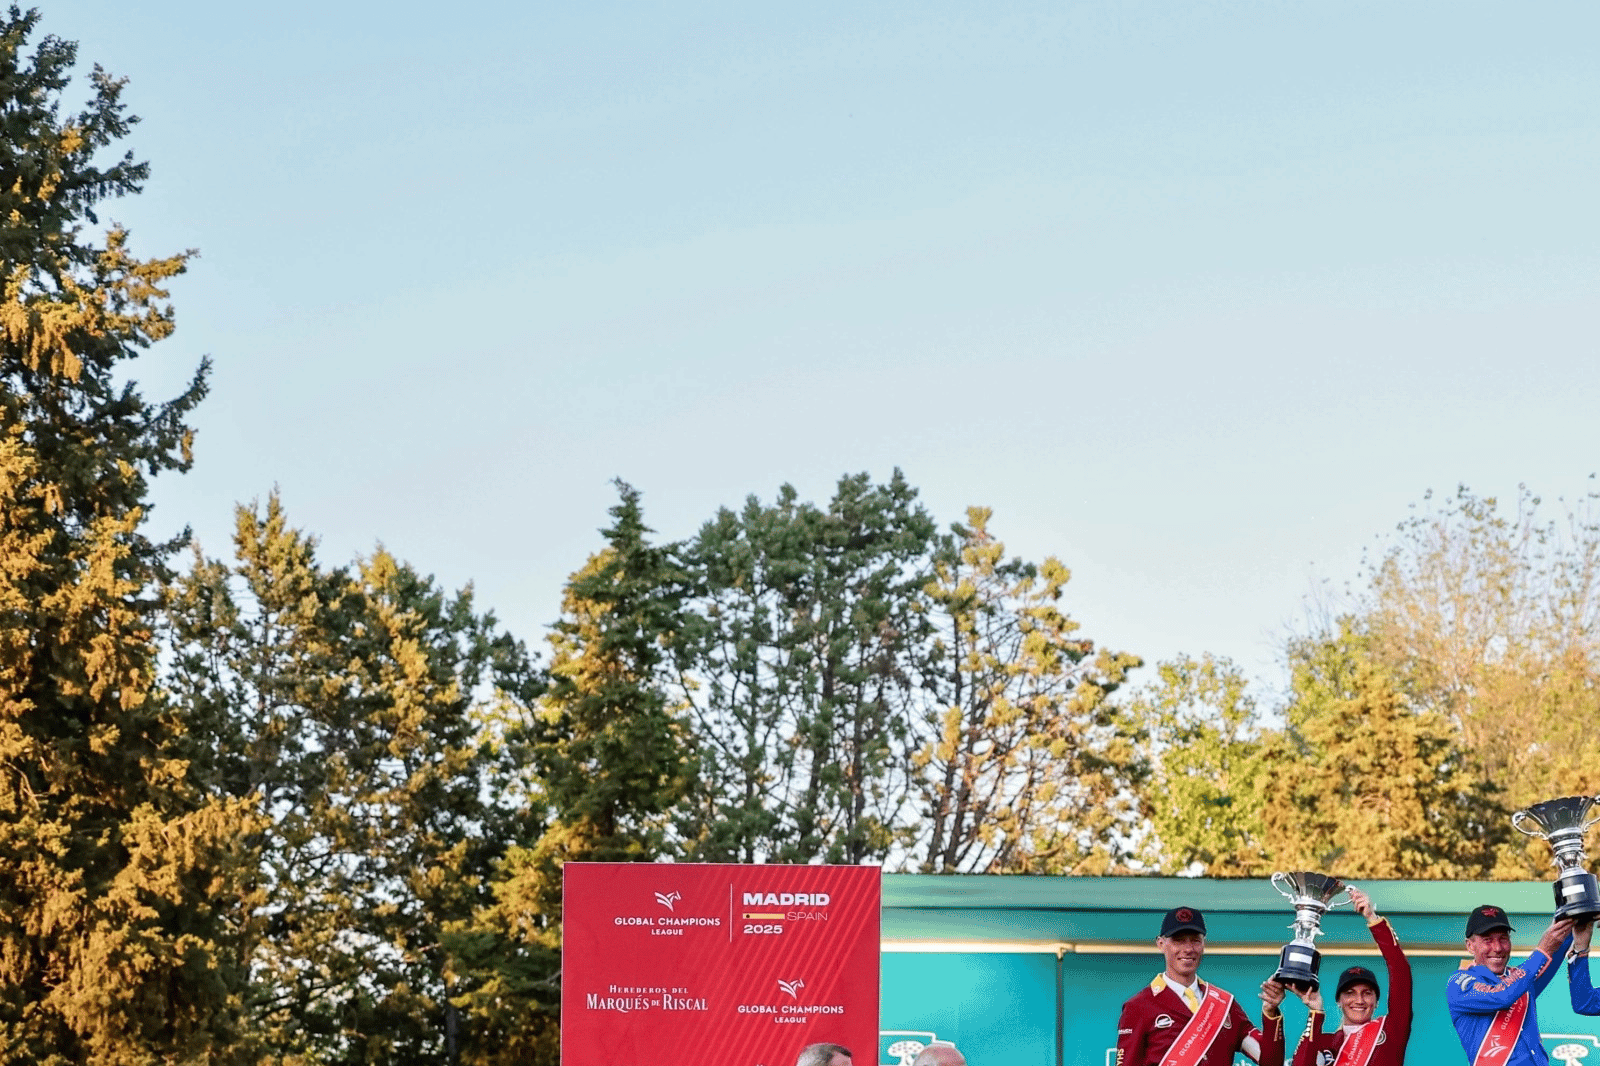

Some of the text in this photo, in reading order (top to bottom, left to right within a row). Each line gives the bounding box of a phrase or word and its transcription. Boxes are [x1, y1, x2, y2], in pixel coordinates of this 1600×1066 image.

[743, 893, 829, 905] MADRID
[787, 912, 827, 920] SPAIN
[615, 917, 720, 926] GLOBAL CHAMPIONS
[743, 925, 782, 934] 2025
[610, 985, 667, 993] HEREDEROS
[587, 993, 649, 1013] MARQUÉS
[663, 994, 708, 1010] RISCAL
[738, 1005, 843, 1014] GLOBAL CHAMPIONS
[1179, 1033, 1198, 1056] GLOBAL
